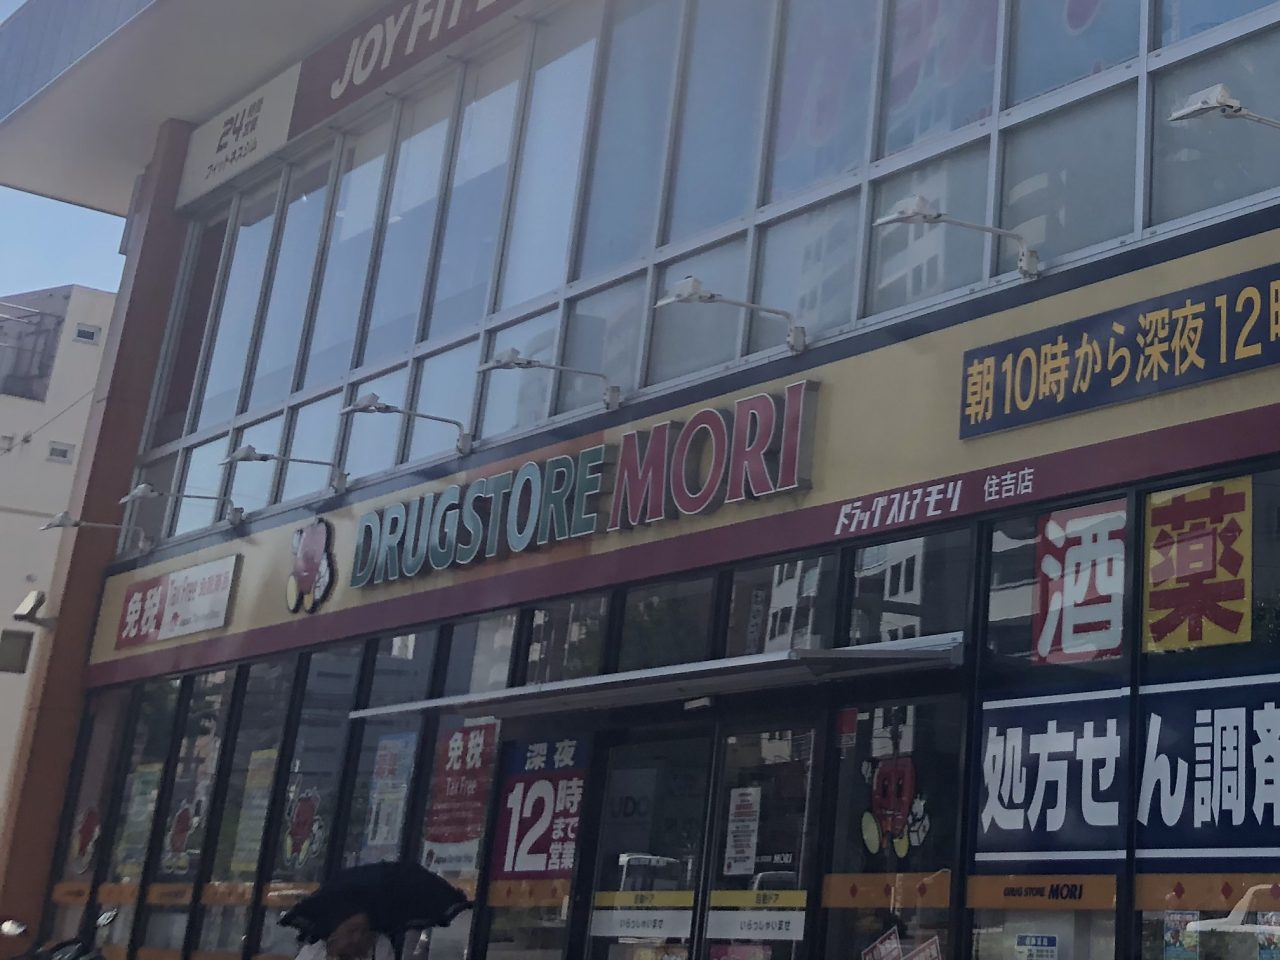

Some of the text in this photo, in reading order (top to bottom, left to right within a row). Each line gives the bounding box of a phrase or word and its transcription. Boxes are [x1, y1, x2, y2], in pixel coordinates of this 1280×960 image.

[607, 379, 806, 530] MORI
[835, 467, 1034, 535] ドラッグストアモリ 住吉店
[1037, 509, 1127, 660] 酒
[1149, 486, 1247, 643] 薬
[121, 586, 162, 639] 免税
[445, 729, 485, 771] 免税
[525, 739, 577, 771] 深夜
[555, 777, 584, 813] 時
[504, 780, 554, 872] 12
[551, 817, 579, 839] まで
[548, 841, 576, 870] 営業
[1048, 884, 1083, 900] MORI
[740, 919, 791, 931] いらっしゃいませ
